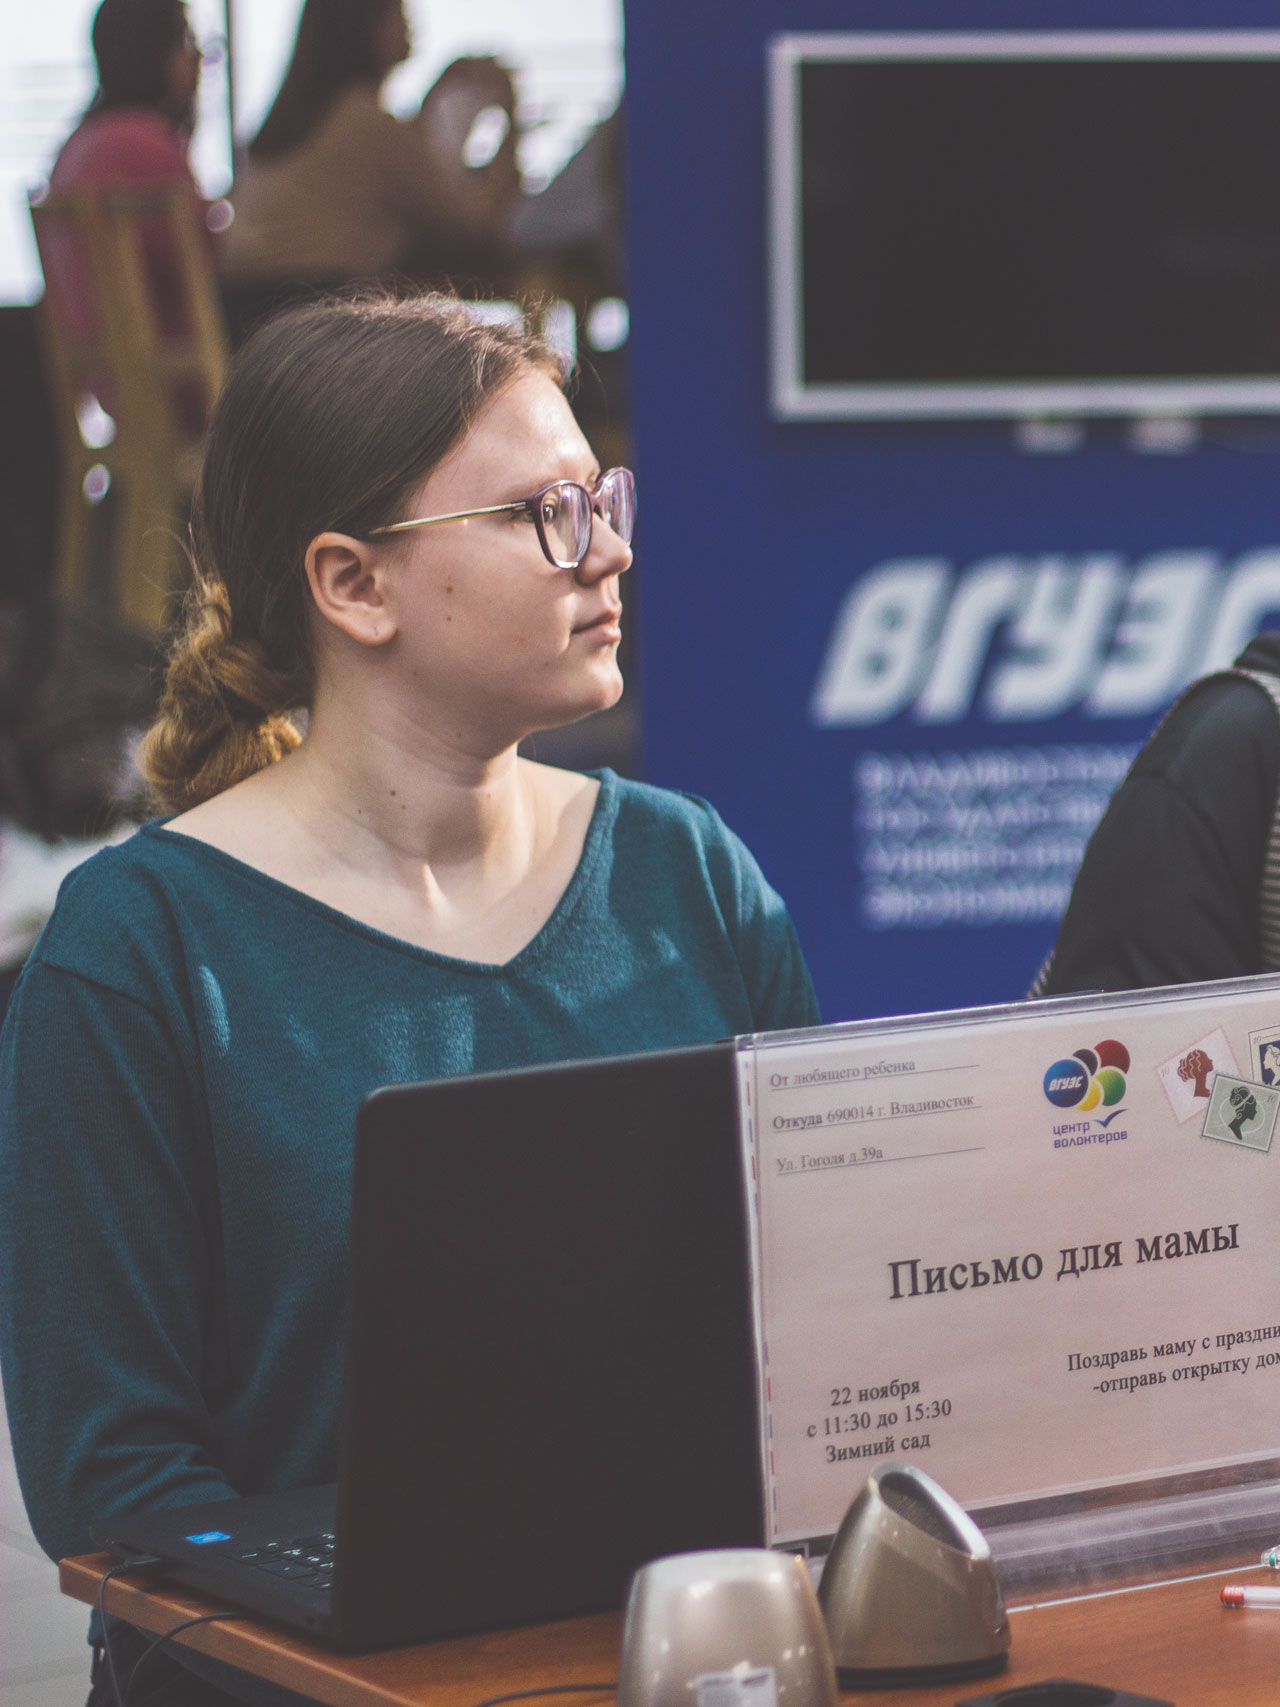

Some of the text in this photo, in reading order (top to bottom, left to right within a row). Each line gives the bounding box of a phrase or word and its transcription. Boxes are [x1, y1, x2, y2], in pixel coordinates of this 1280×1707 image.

[770, 1059, 916, 1087] От любящего ребенка
[1047, 1074, 1084, 1092] ВГУЭС
[772, 1095, 974, 1130] Откуда 690014 г. Владивосток
[1053, 1121, 1090, 1136] центр
[1053, 1130, 1128, 1149] волонтеров
[776, 1157, 796, 1173] Ул.
[801, 1151, 845, 1169] Гоголя
[888, 1223, 1240, 1300] Письмо для мамы
[1067, 1347, 1148, 1371] Поздравь
[1153, 1338, 1196, 1358] маму
[1202, 1337, 1210, 1350] с
[1093, 1369, 1166, 1393] -отправь
[1172, 1356, 1250, 1381] открытку
[831, 1379, 920, 1406] 22 ноября
[807, 1399, 952, 1438] с 11:30 до 15:30
[826, 1434, 931, 1463] Зимний сад
